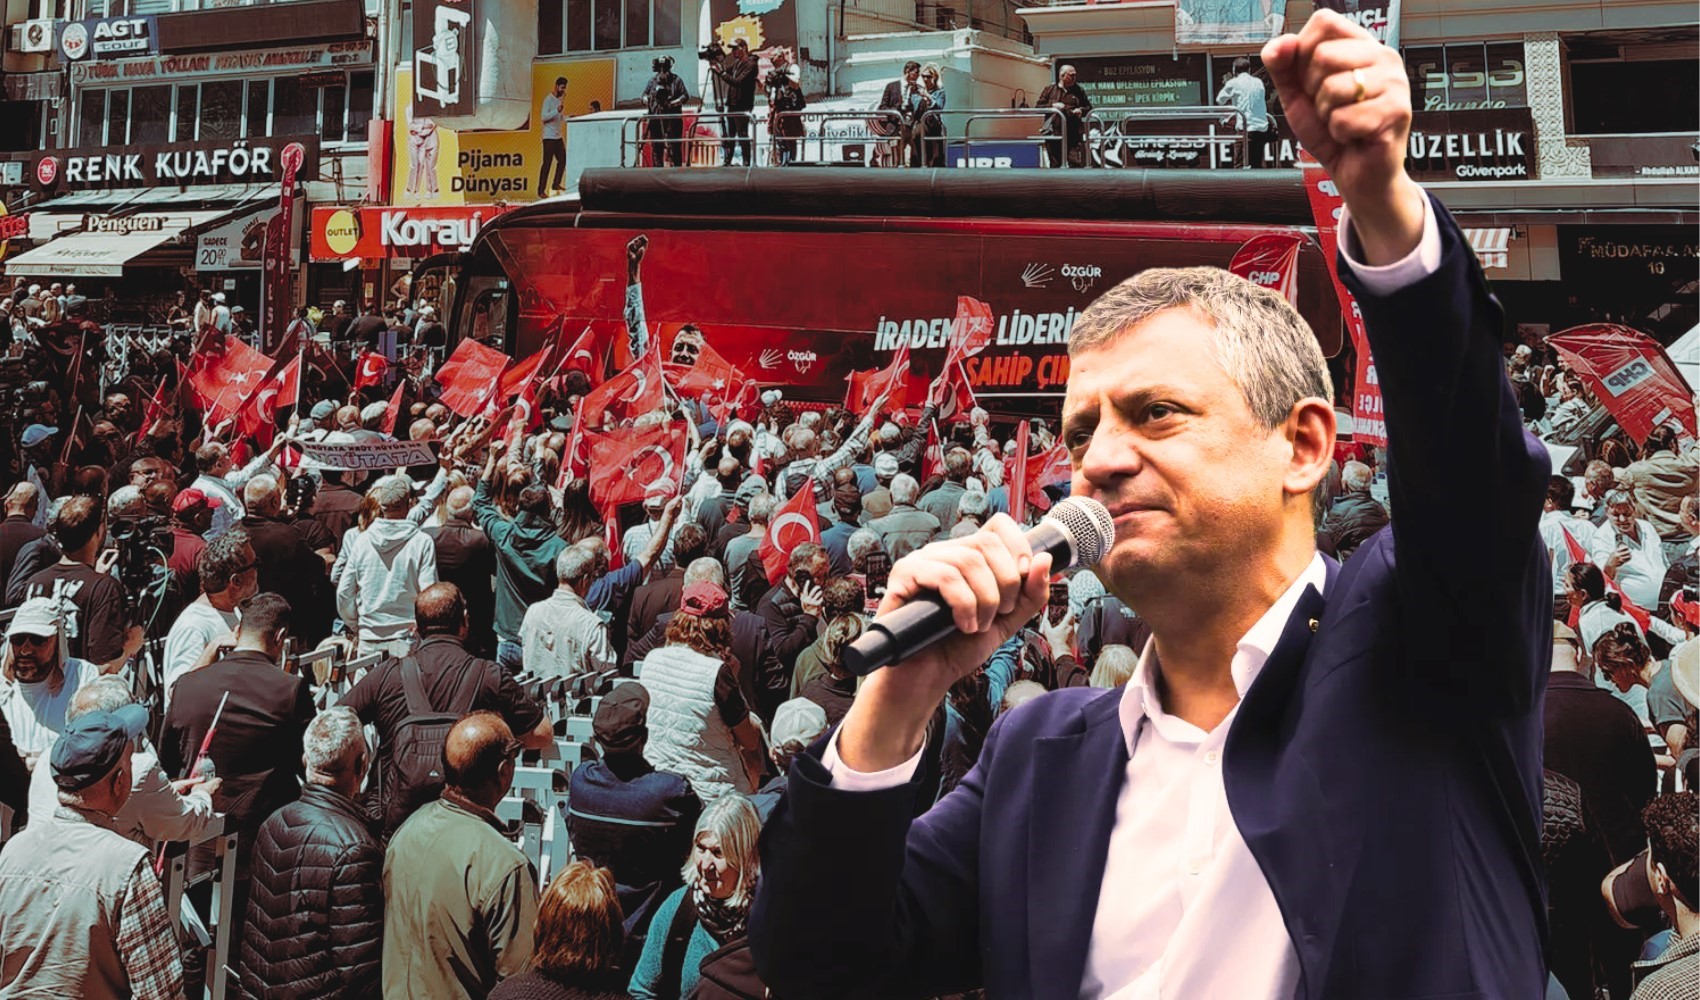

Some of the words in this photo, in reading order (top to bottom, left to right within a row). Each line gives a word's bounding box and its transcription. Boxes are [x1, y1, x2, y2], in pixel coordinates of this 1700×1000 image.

[93, 19, 147, 39] AGT
[98, 40, 142, 51] tour
[1408, 129, 1526, 159] ÜZELLİK
[66, 155, 142, 183] RENK
[154, 140, 272, 179] KUAFÖR
[458, 148, 524, 173] Pijama
[1455, 163, 1527, 178] Güvenpark
[451, 174, 528, 196] Dünyası
[87, 215, 159, 235] Penguen
[327, 228, 359, 237] OUTLET
[381, 211, 483, 253] Koray
[200, 249, 217, 265] 20
[1060, 263, 1102, 278] ÖZGÜR
[1648, 262, 1665, 275] 10
[1248, 271, 1280, 285] CHP
[787, 349, 817, 362] ÖZGÜR
[966, 351, 1032, 387] SAHİP
